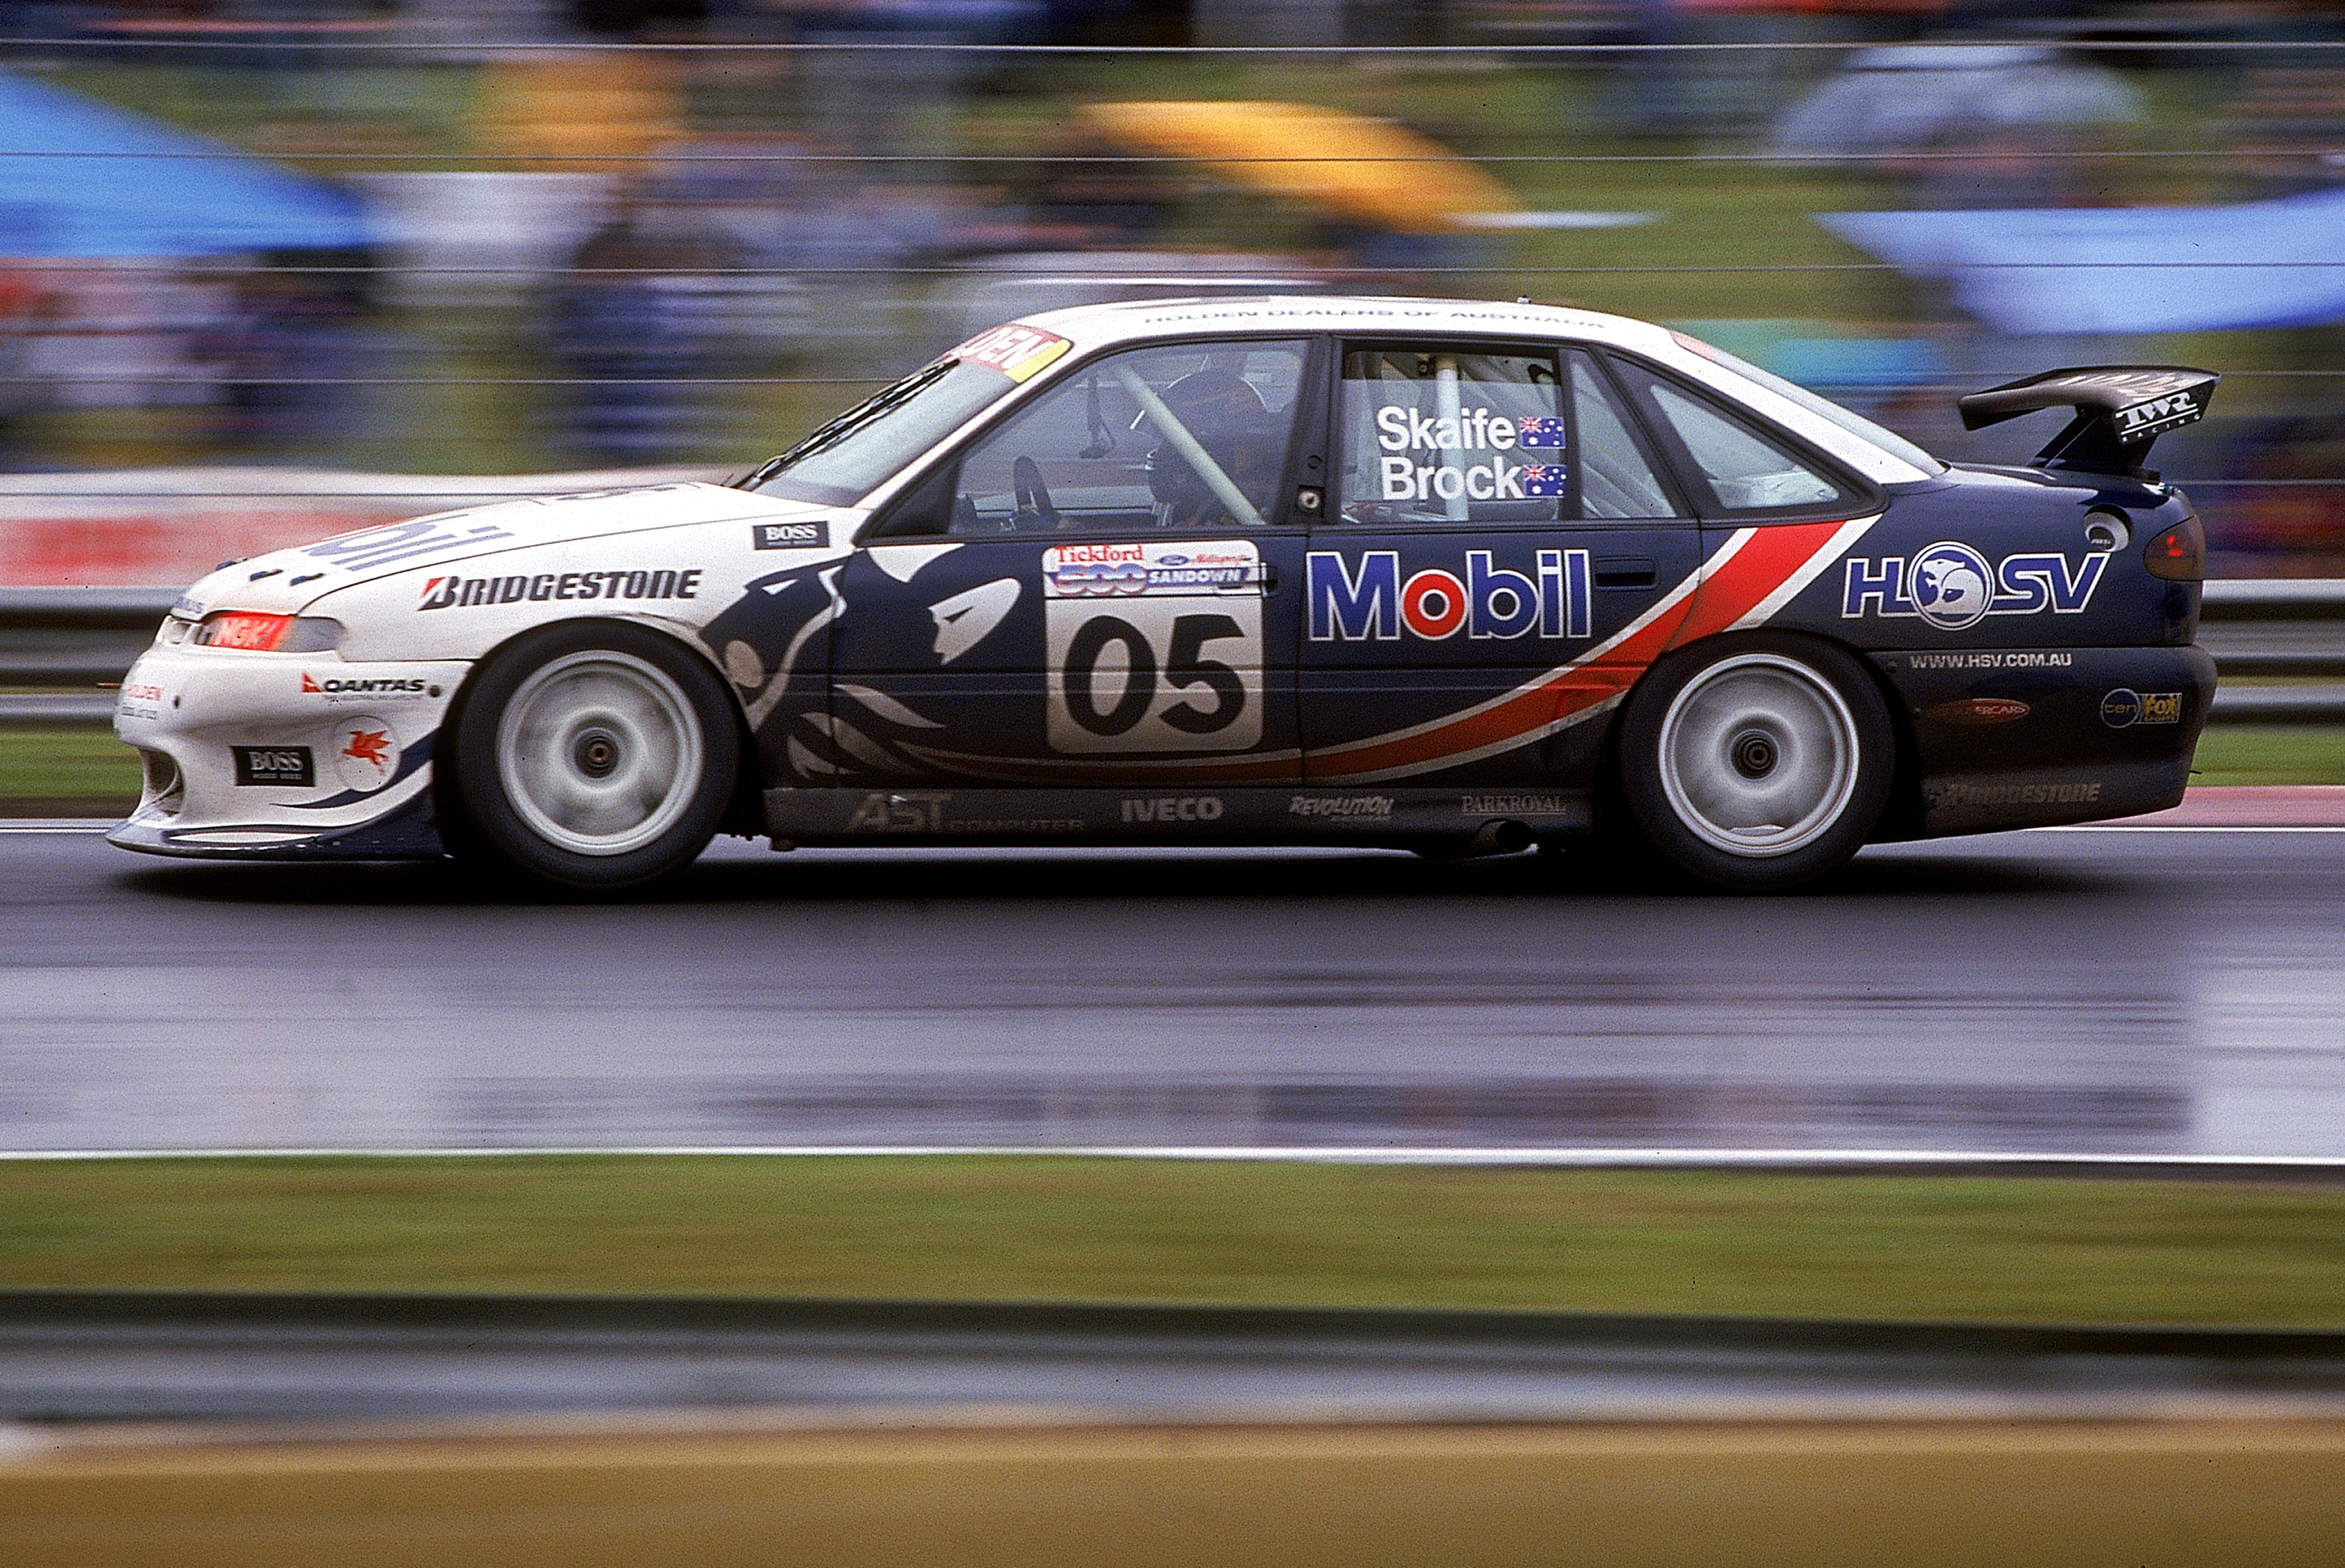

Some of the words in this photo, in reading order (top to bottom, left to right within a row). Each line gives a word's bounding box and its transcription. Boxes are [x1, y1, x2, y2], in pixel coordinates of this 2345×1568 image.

[1145, 311, 1258, 323] HOLDEN
[1451, 311, 1604, 329] AUSTRALIA
[960, 326, 1055, 369] DEN
[2115, 391, 2197, 428] TWR
[1378, 405, 1516, 450] Skaife
[1381, 455, 1525, 500] Brock
[765, 524, 818, 541] BOSS
[1054, 545, 1144, 563] Tickford
[417, 569, 702, 611] BRIDGESTONE
[1054, 563, 1148, 594] 500
[1149, 568, 1242, 584] SANDOWN
[1306, 548, 1591, 641] Mobil
[1911, 653, 2072, 669] WWW.HSV.COM.AU
[324, 678, 426, 692] QANTAS
[1063, 613, 1247, 737] 05
[2104, 703, 2138, 714] ten
[248, 751, 304, 772] BOSS
[846, 792, 952, 832] AST
[1123, 798, 1224, 822] IVECO
[1288, 795, 1395, 816] REVOLUTION
[1461, 795, 1567, 813] PARKROYAL
